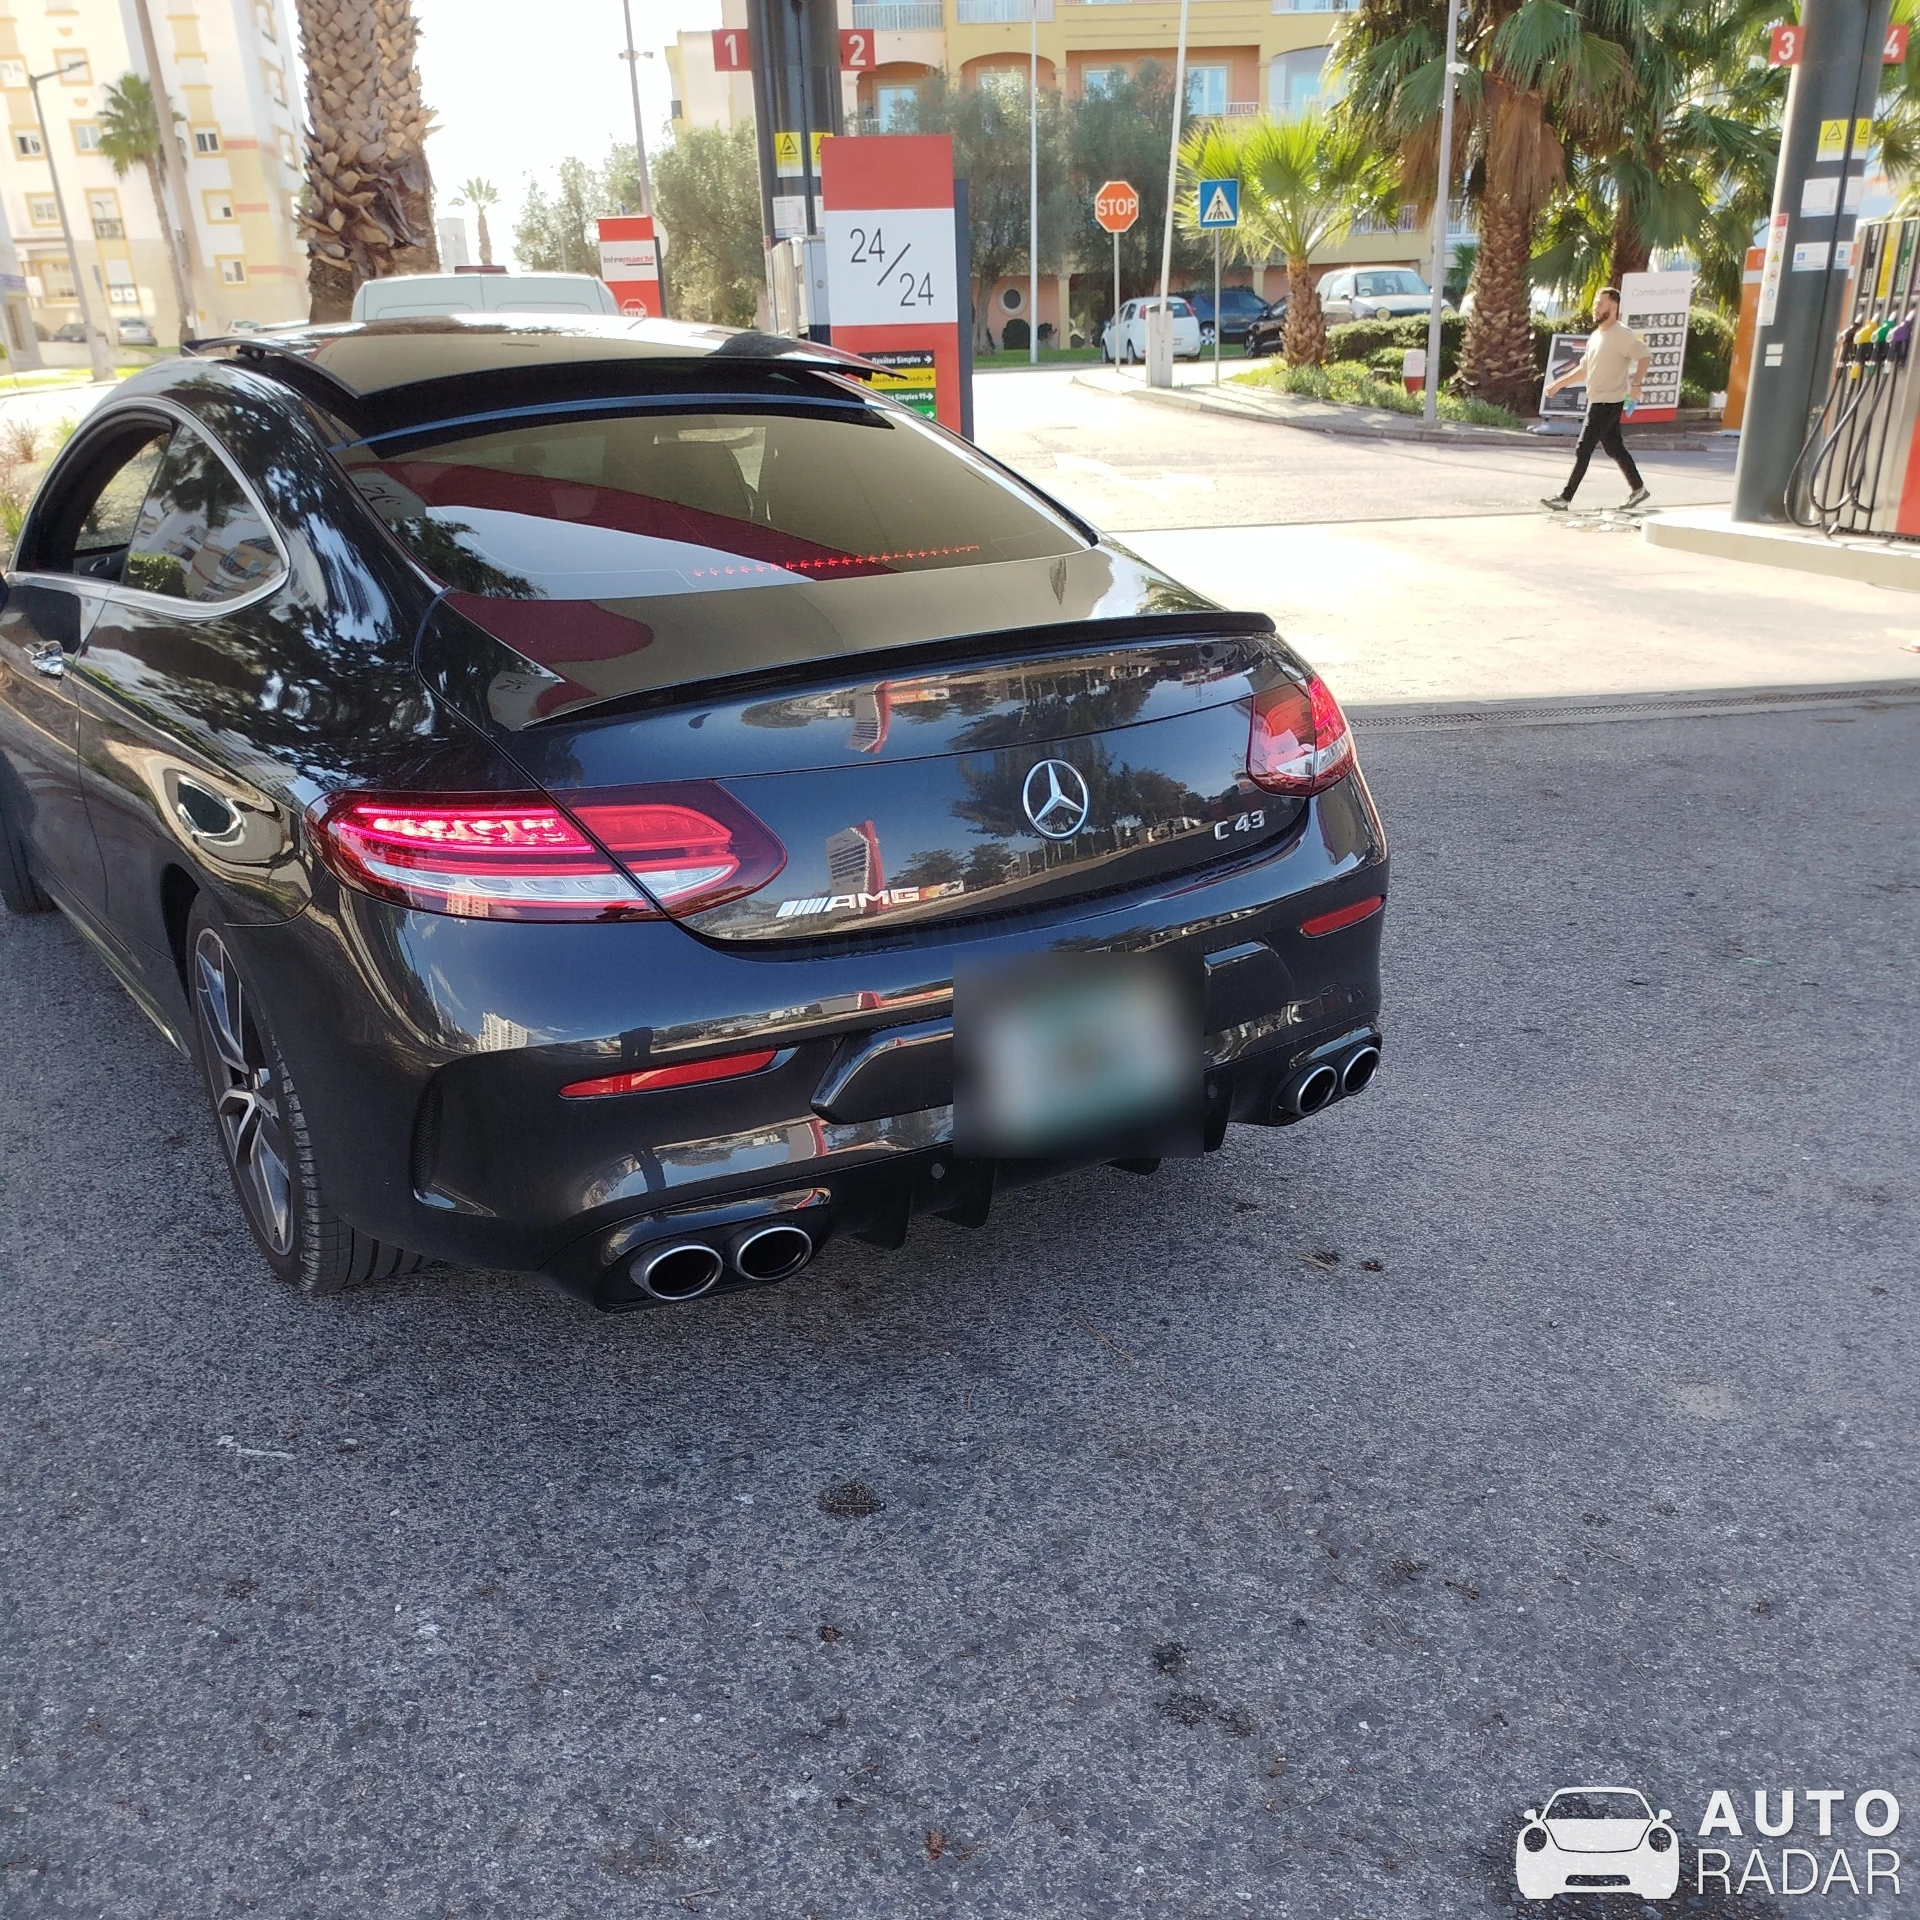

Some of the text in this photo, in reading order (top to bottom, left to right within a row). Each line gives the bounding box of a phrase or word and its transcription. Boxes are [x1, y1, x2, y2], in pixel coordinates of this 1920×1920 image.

[724, 34, 738, 66] 1
[848, 34, 867, 66] 2
[1778, 31, 1795, 60] 3
[1883, 29, 1899, 58] 4
[1098, 198, 1136, 217] STOP
[623, 307, 647, 317] STOP
[1649, 352, 1680, 365] .668
[1214, 810, 1265, 840] C 43
[823, 886, 889, 912] AMG
